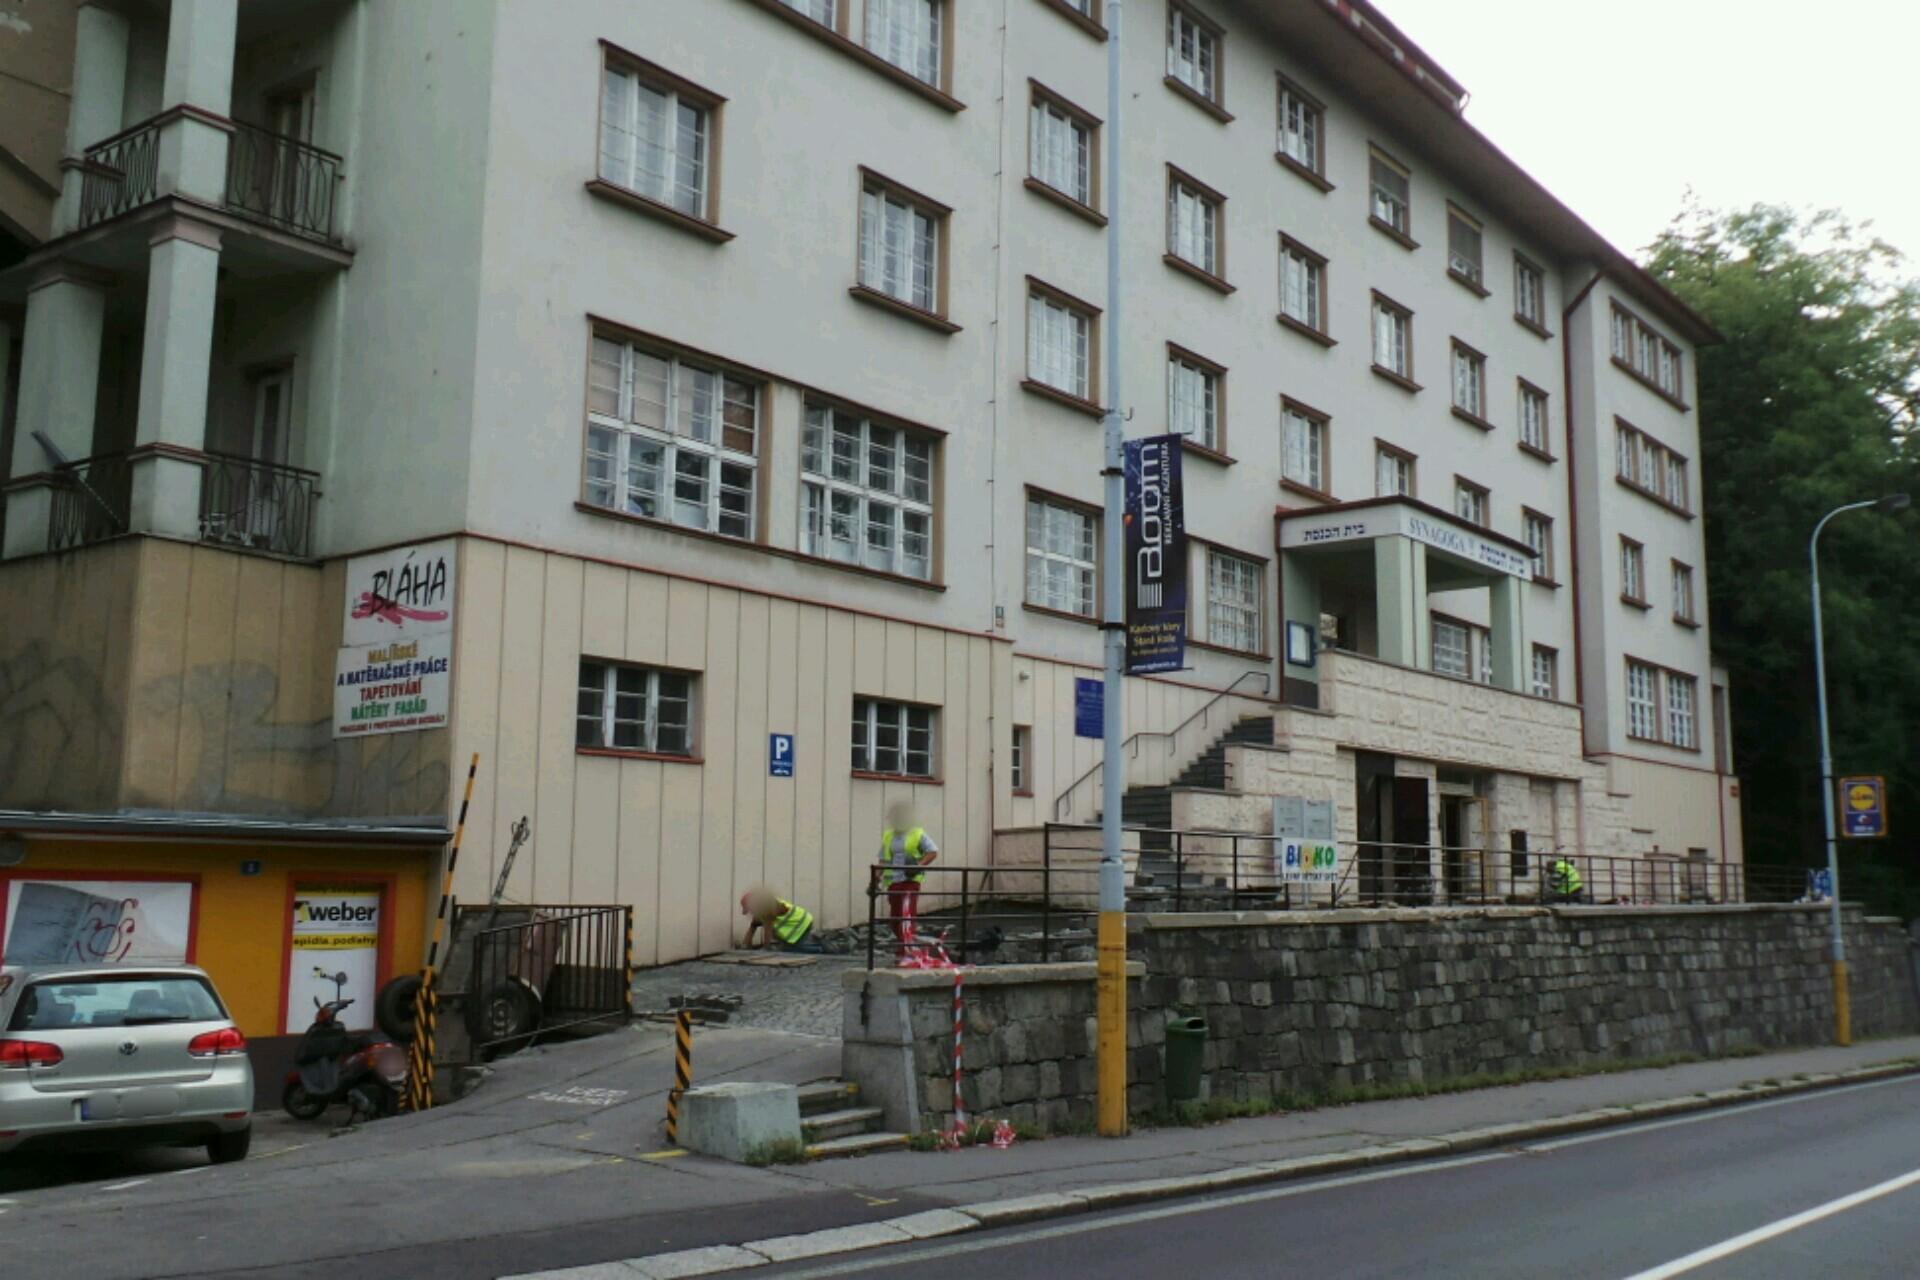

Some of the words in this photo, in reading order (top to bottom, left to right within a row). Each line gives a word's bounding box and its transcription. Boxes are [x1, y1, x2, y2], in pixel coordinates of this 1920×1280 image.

[1160, 442, 1170, 493] AGENTURA
[1409, 516, 1466, 553] SYNAGOGA
[337, 673, 344, 686] A
[413, 656, 448, 675] PRÁCE
[360, 677, 422, 701] TAPETOVÁNÍ
[394, 696, 427, 716] FASÁD
[776, 736, 789, 760] P
[308, 901, 376, 921] weber
